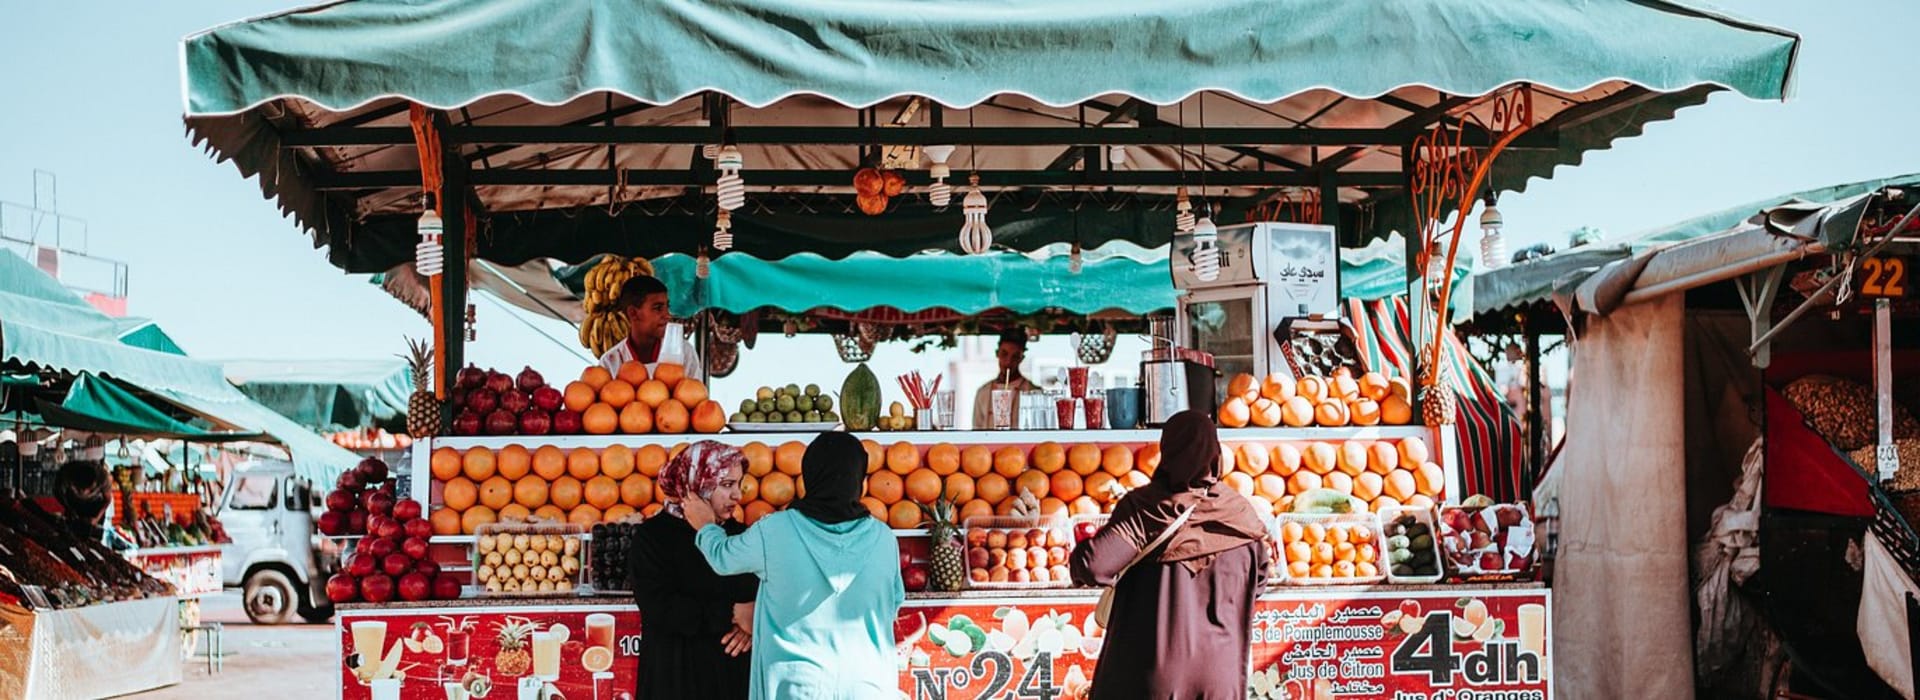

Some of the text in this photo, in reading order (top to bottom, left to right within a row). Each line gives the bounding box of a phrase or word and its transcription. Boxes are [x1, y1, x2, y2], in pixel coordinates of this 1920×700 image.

[1862, 257, 1903, 295] 22
[1265, 625, 1281, 641] de
[1285, 623, 1383, 642] Pomplemousse
[1290, 661, 1384, 679] Jus de Citron
